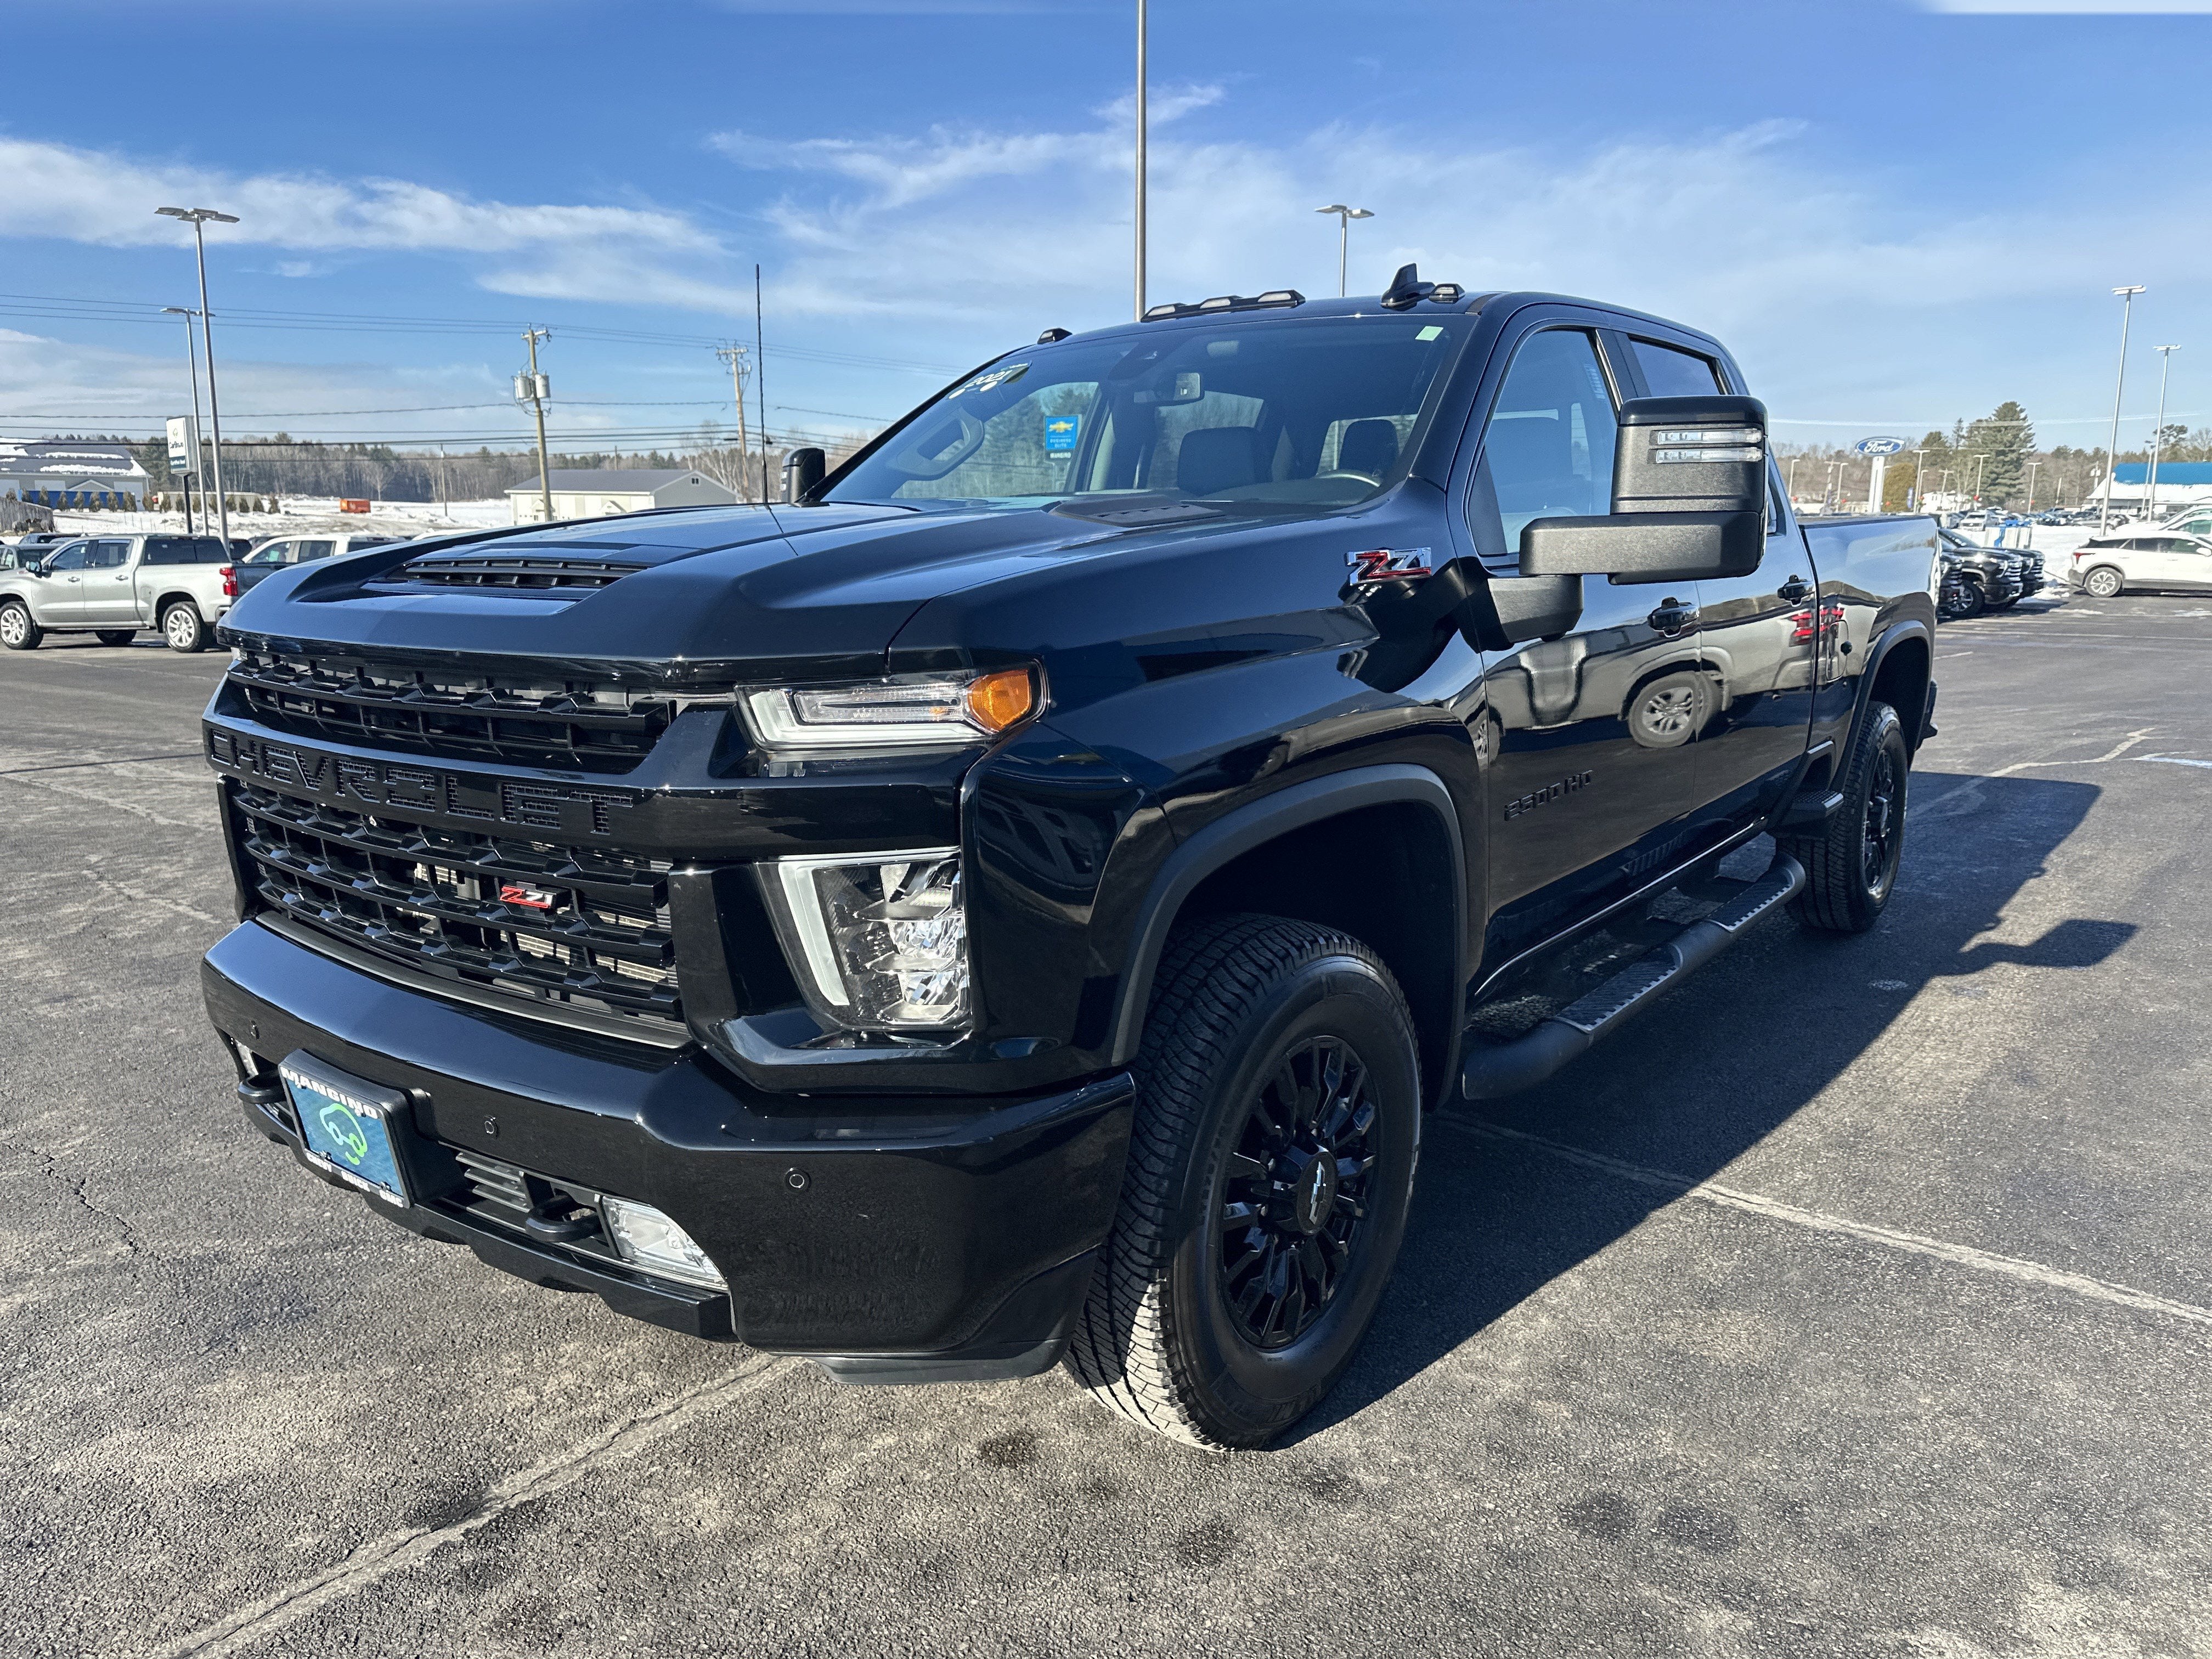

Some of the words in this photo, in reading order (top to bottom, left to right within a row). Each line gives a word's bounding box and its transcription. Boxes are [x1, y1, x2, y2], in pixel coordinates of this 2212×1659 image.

[1864, 440, 1894, 453] Ford
[1344, 547, 1432, 586] Z71
[211, 727, 634, 836] CHEVROLET
[500, 885, 550, 909] Z71
[341, 1170, 370, 1192] BUICK
[379, 1189, 403, 1207] GMC
